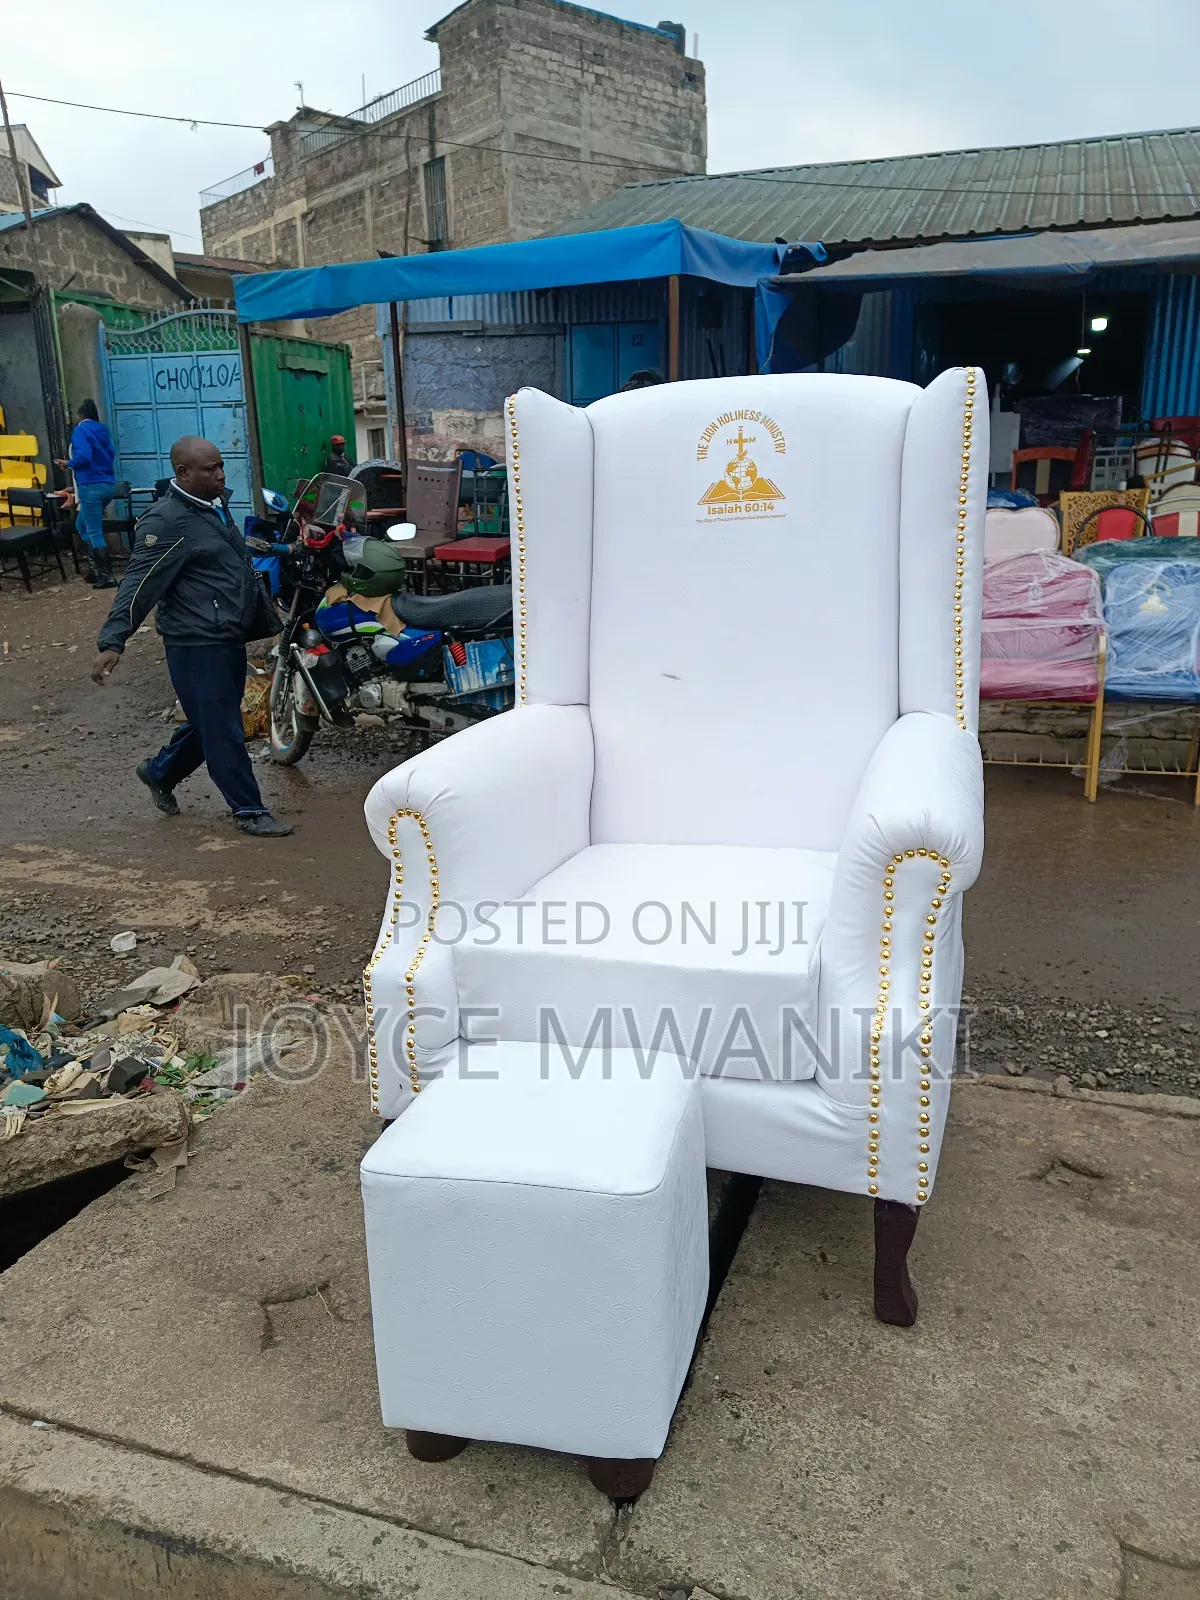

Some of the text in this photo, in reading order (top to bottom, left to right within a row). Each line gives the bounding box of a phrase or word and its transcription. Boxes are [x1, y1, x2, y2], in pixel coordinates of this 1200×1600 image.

[697, 409, 786, 461] THE ZION HOLINESS MINISTRY
[708, 502, 775, 515] Isaiah 60:14
